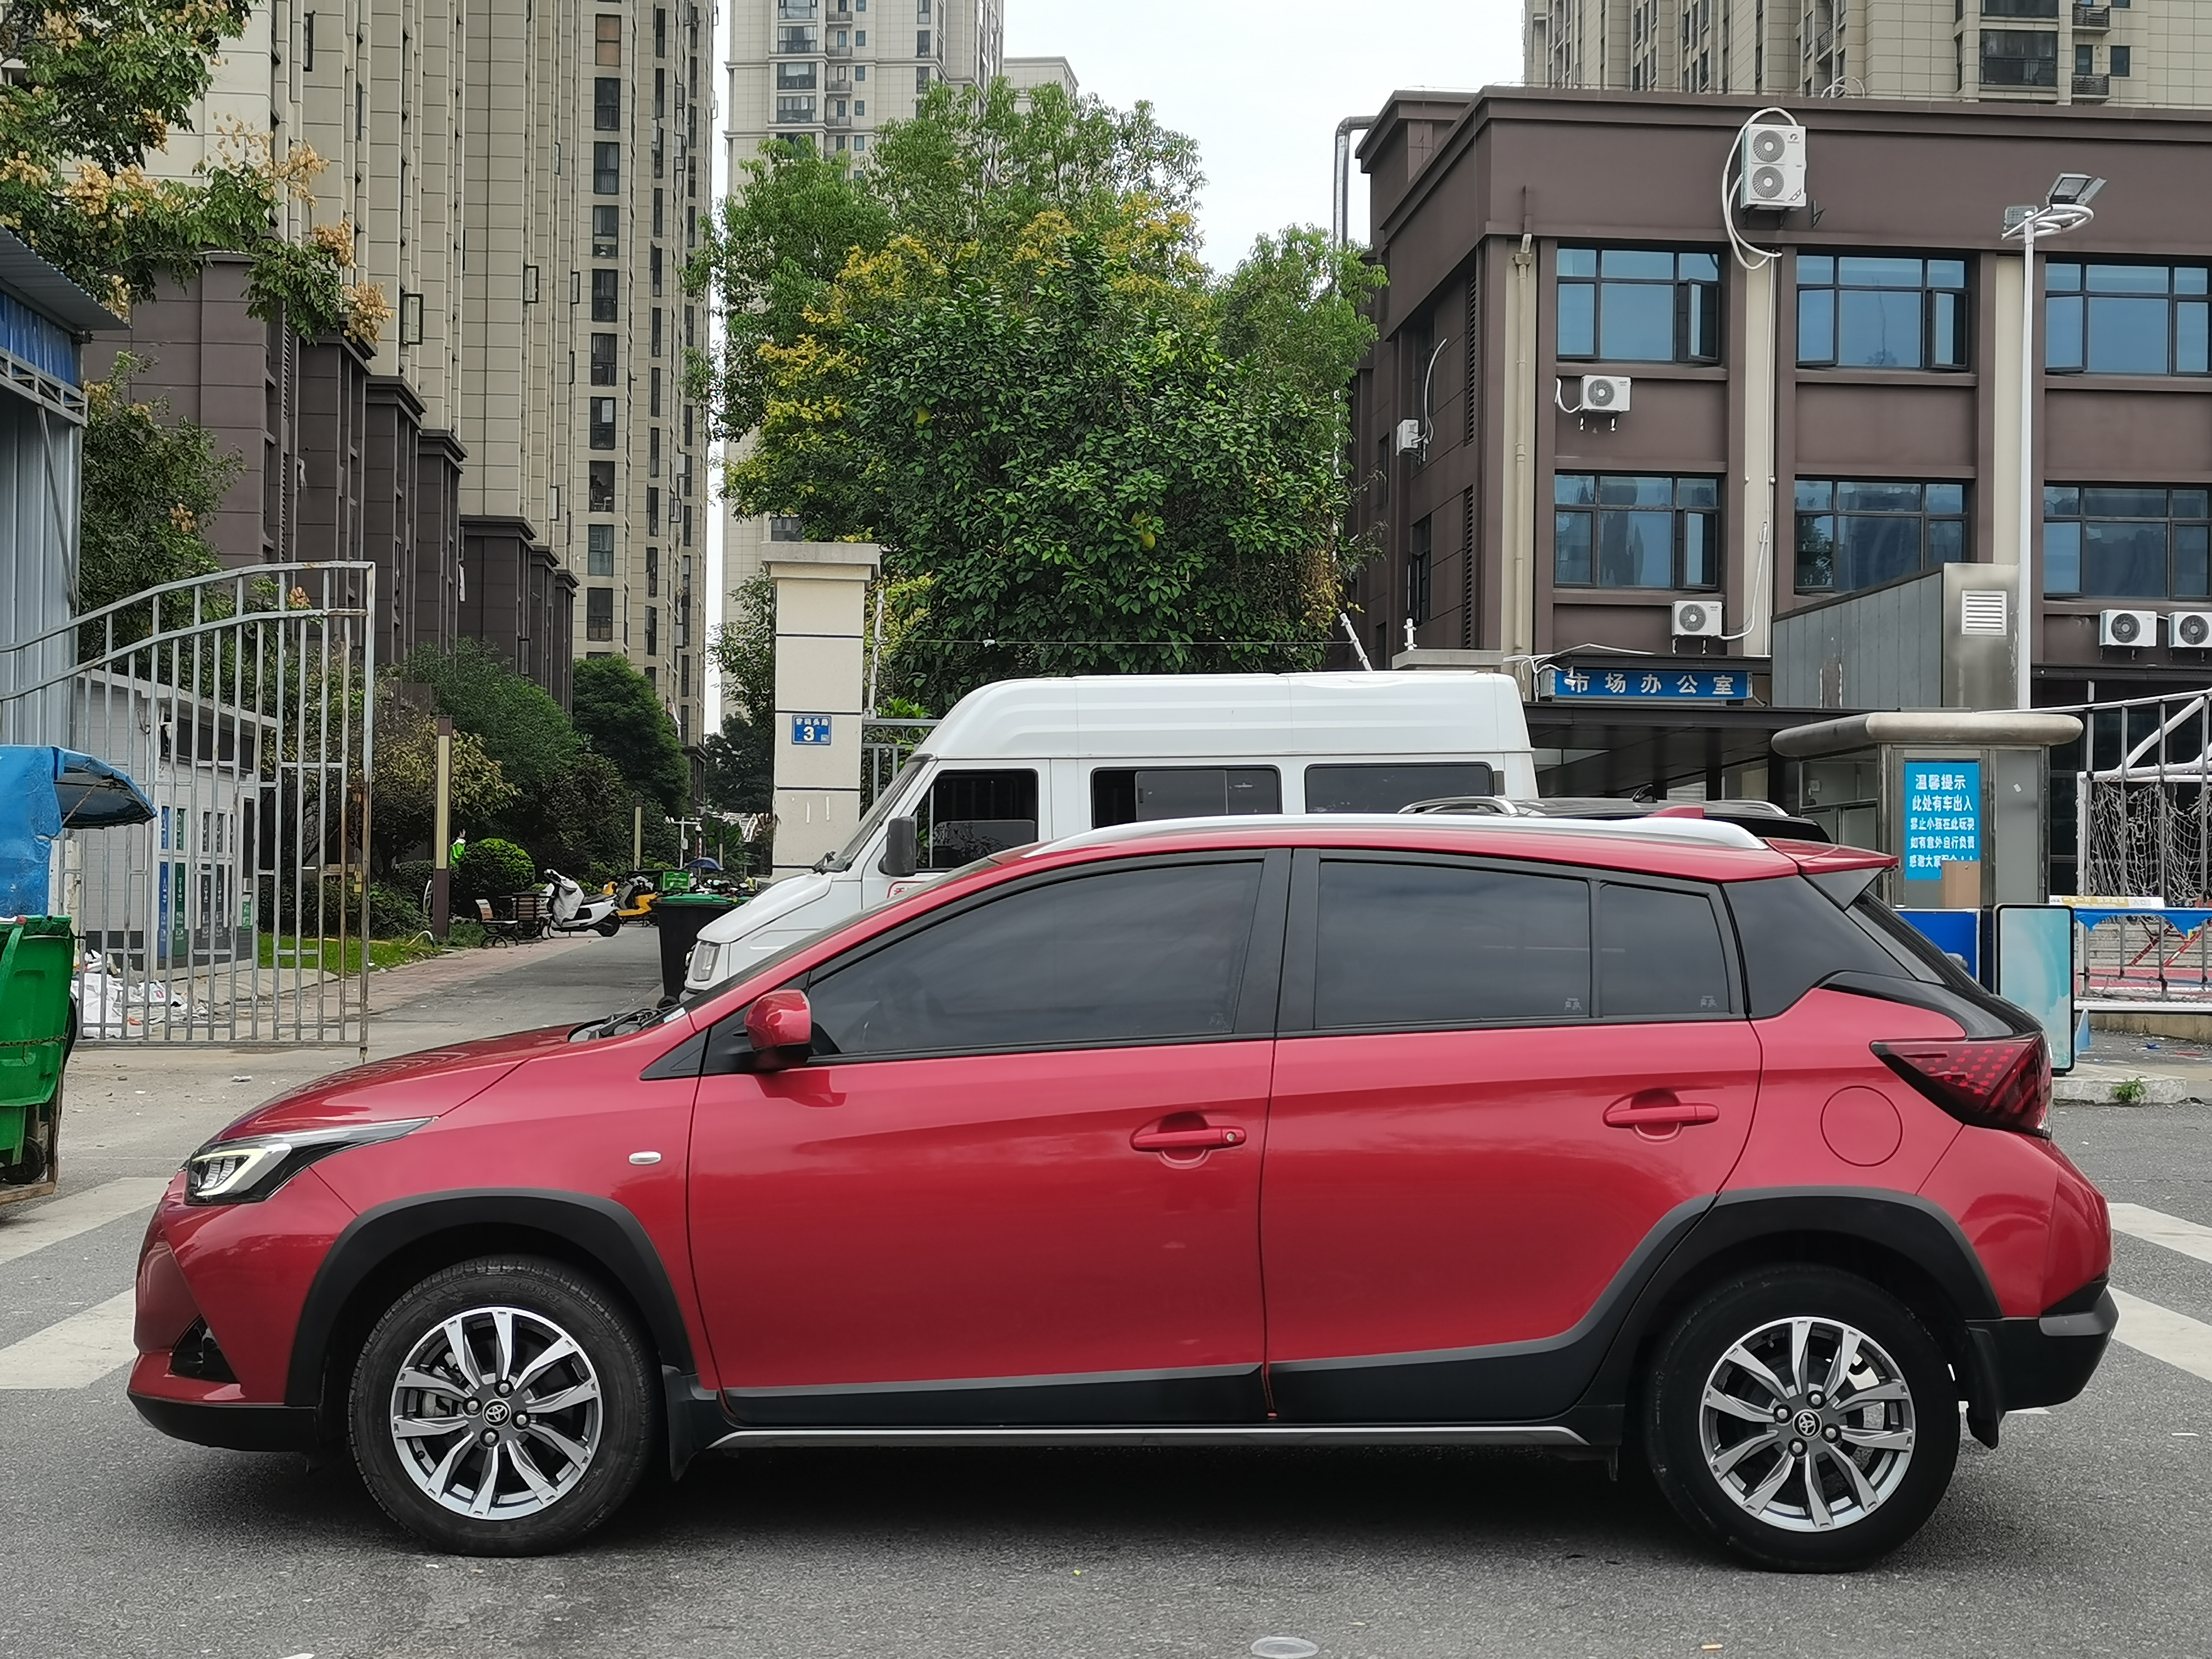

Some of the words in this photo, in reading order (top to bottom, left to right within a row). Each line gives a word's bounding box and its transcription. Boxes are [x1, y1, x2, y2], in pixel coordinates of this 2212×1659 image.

[1570, 673, 1734, 695] 市场办公室
[803, 726, 815, 741] 3
[1915, 774, 1966, 790] 温馨提示
[1912, 794, 1973, 812] 此处有车出入
